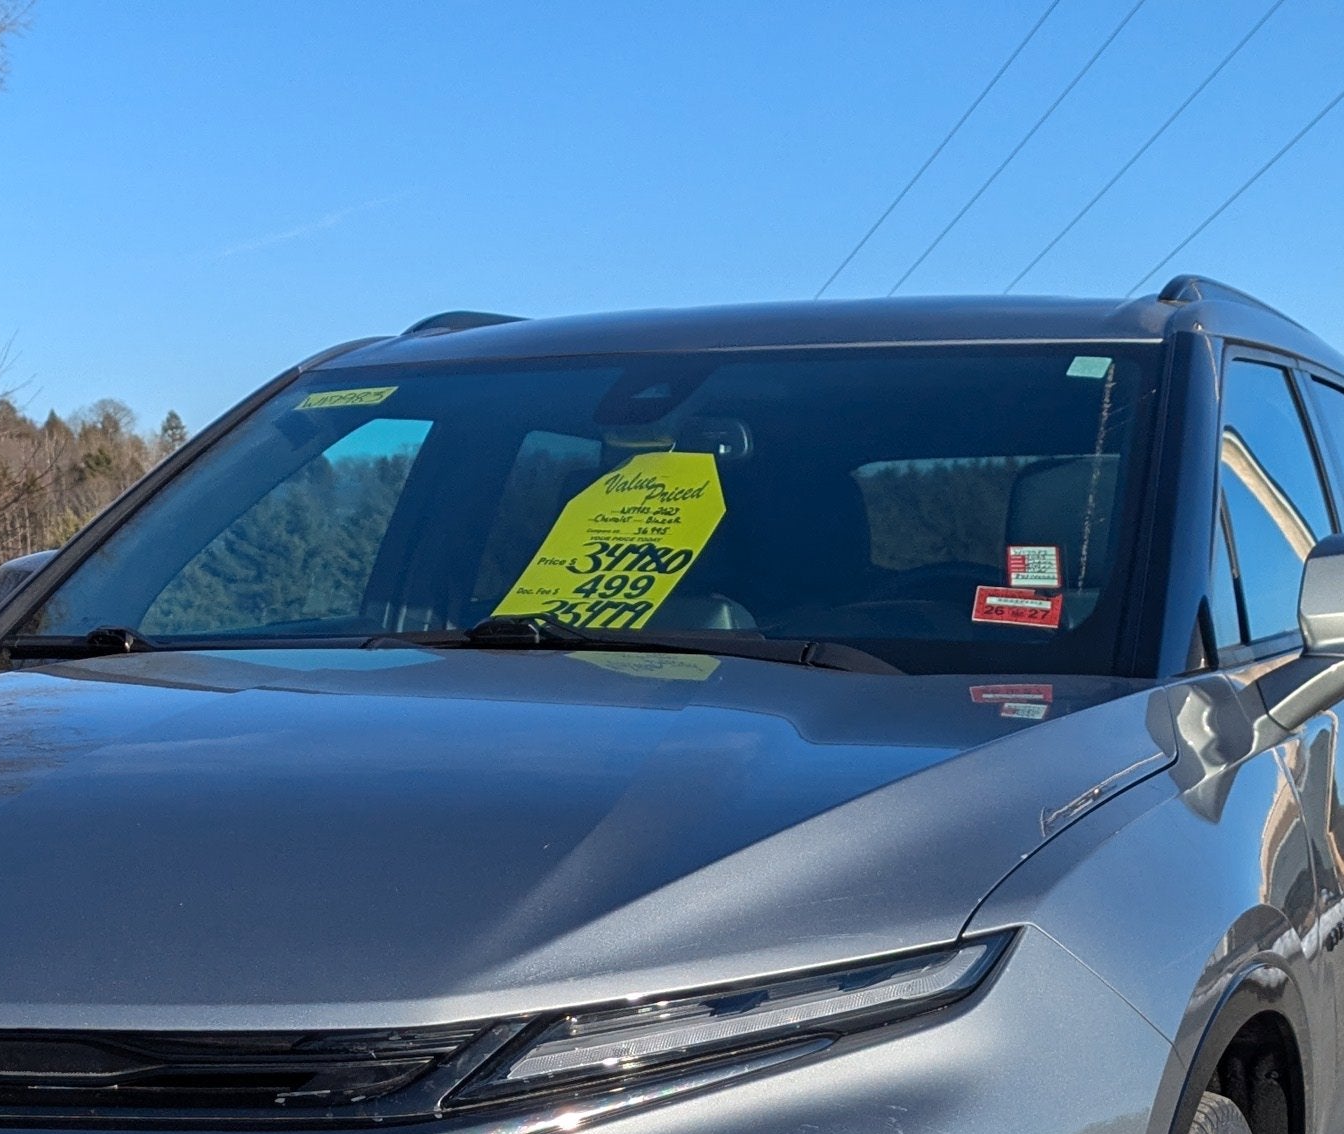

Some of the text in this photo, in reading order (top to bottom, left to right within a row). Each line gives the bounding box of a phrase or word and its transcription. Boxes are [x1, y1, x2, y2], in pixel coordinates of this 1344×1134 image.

[604, 472, 657, 495] Value
[641, 479, 710, 506] Priced
[537, 557, 566, 566] Price
[536, 587, 552, 595] Fee
[572, 573, 656, 599] 499
[983, 605, 1005, 616] 26
[1027, 608, 1050, 620] 27
